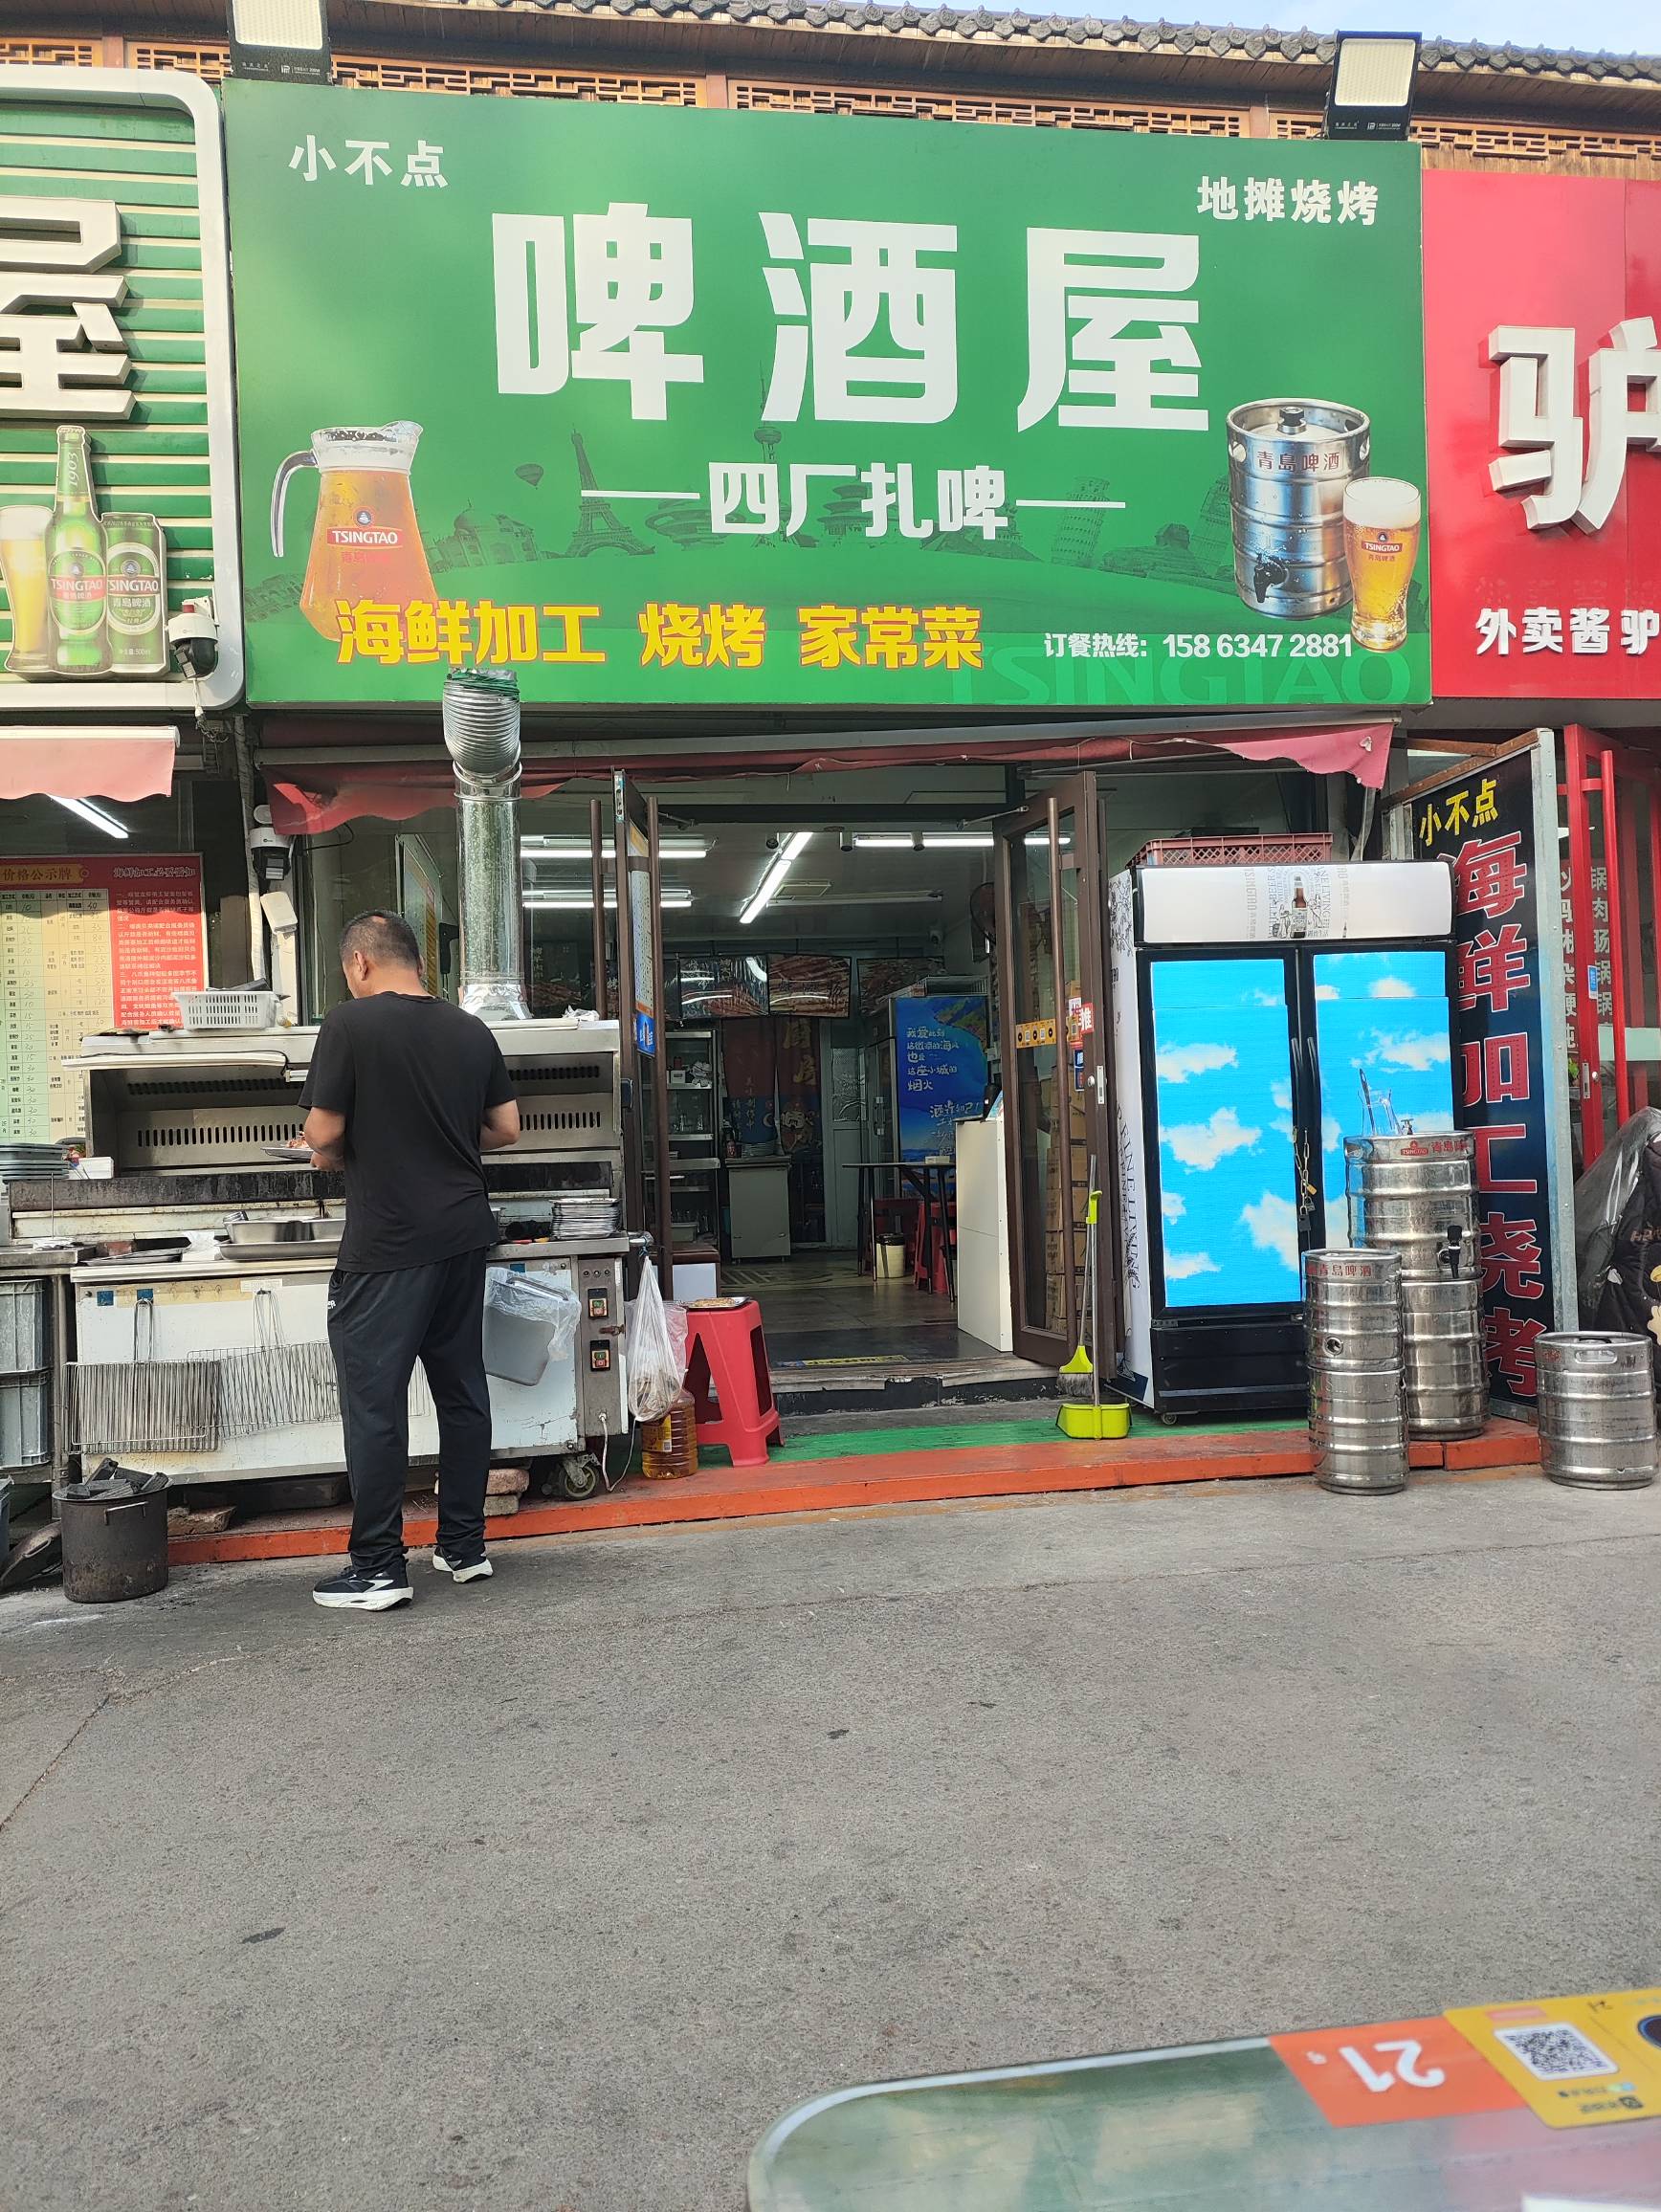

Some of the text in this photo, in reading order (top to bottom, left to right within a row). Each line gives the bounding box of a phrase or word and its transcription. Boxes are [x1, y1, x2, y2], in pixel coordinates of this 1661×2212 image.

[288, 135, 449, 188] 小不点
[1197, 175, 1379, 226] 地摊烧烤
[492, 202, 1209, 432] 啤酒屋
[68, 453, 78, 487] 1903
[709, 462, 1009, 541] 四厂扎啤
[332, 530, 398, 544] TSINGTAO
[1365, 542, 1400, 552] TSINGTAO
[51, 578, 103, 590] TSINGTAO
[335, 598, 984, 670] 海鲜加工 烧烤 家常菜
[1163, 633, 1211, 657] 158
[1216, 633, 1283, 657] 6347
[1289, 633, 1354, 657] 2881
[1475, 607, 1660, 655] 外卖酱驴
[1419, 779, 1498, 847] 小不点
[3, 867, 73, 881] 价格公示牌
[907, 1078, 934, 1092] 烟火
